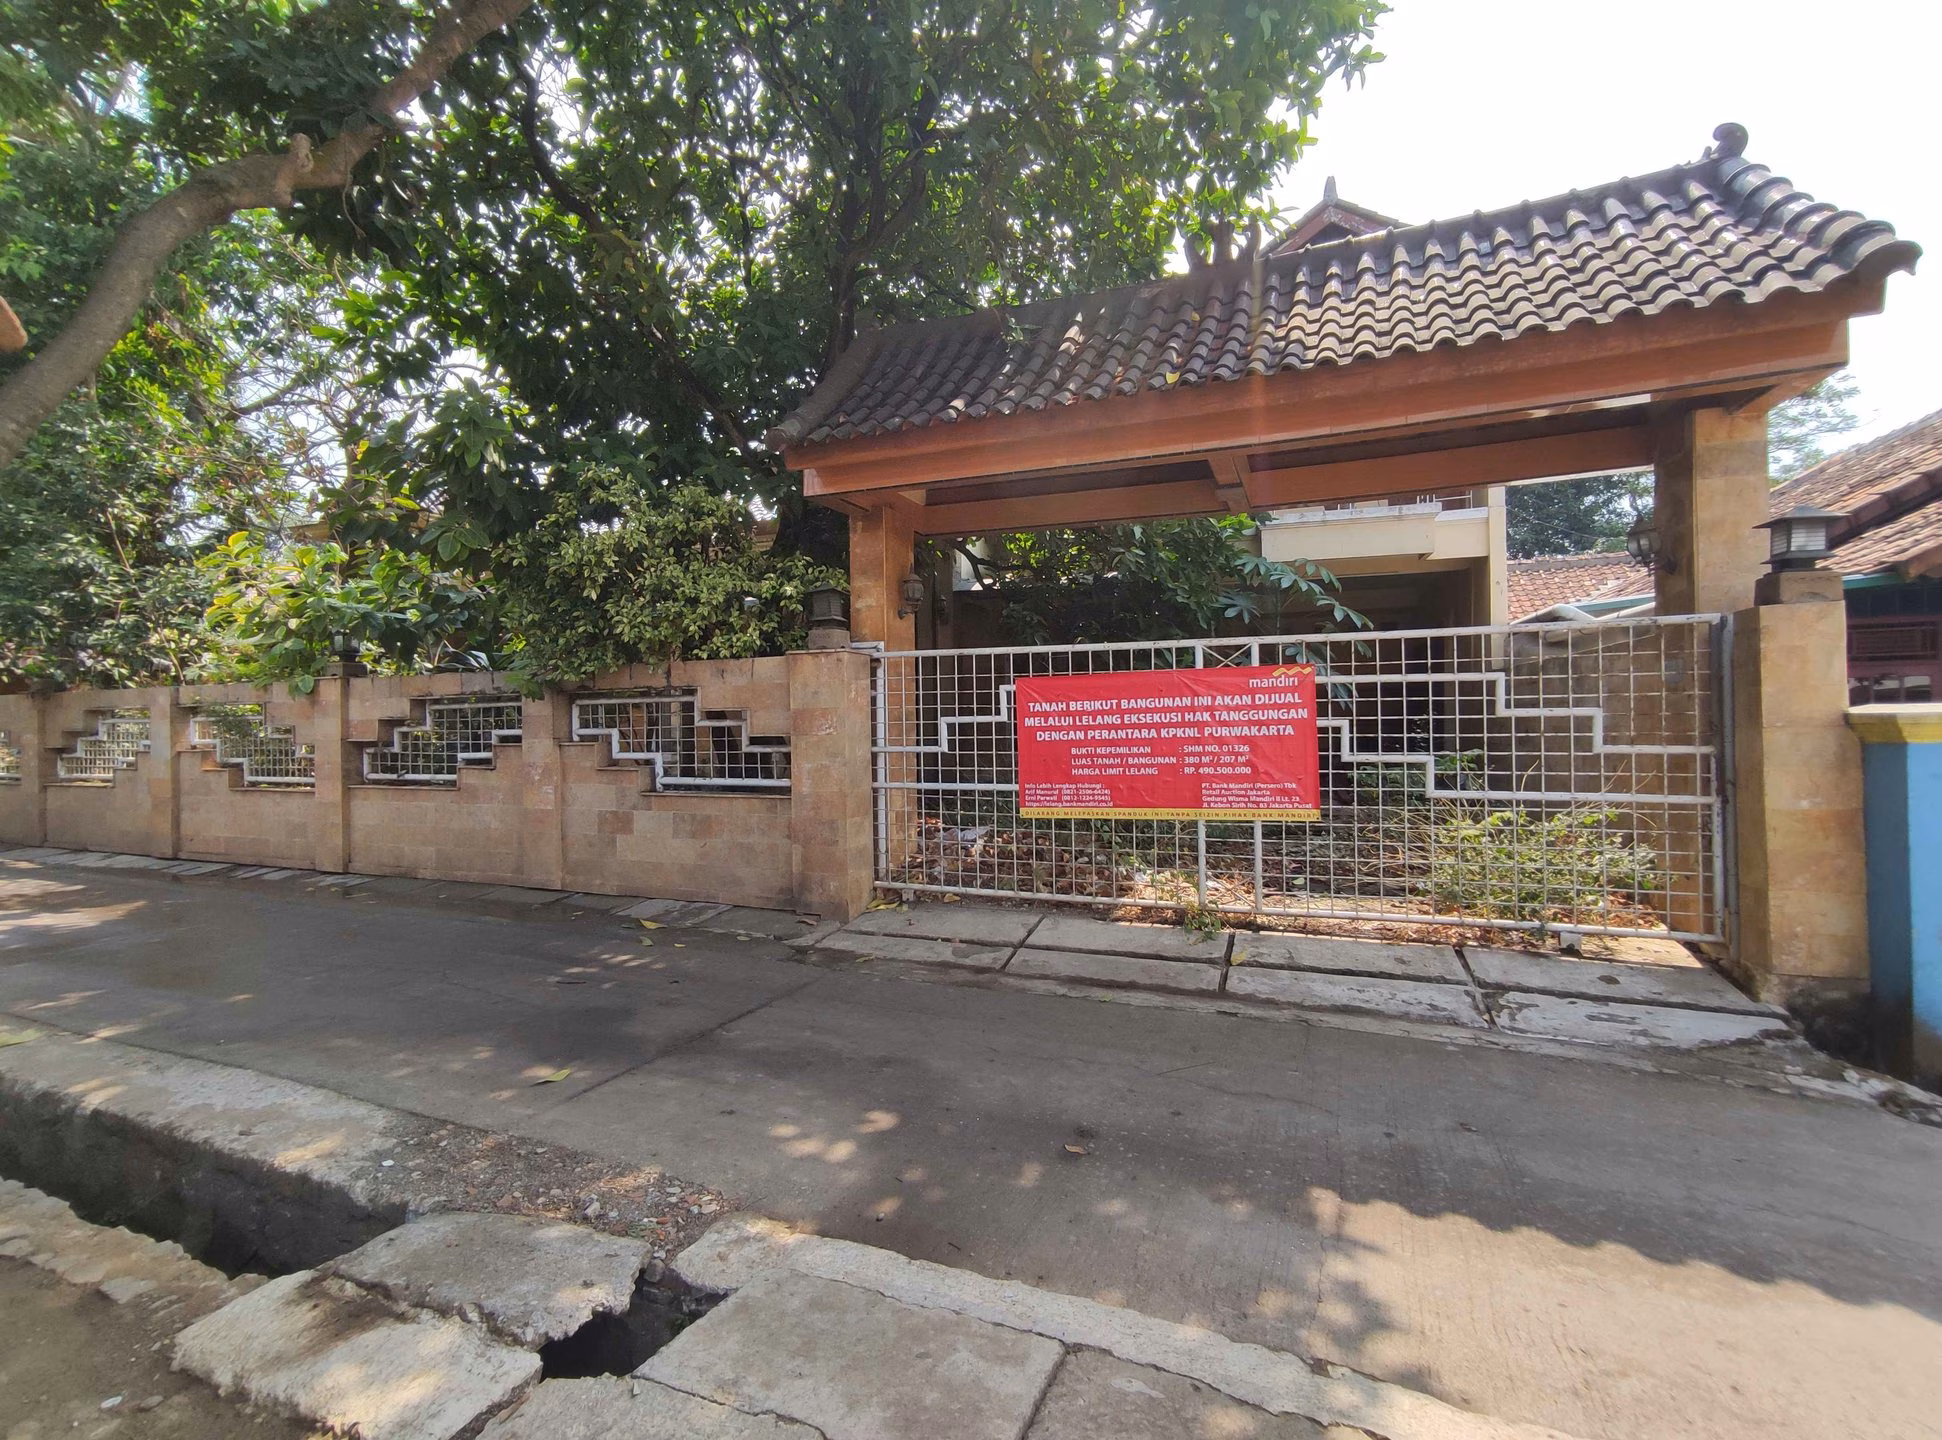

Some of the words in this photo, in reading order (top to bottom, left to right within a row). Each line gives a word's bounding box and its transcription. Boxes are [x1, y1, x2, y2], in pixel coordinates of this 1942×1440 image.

[1249, 675, 1298, 688] mandiri
[1028, 702, 1066, 712] TANAH
[1069, 700, 1118, 711] BERIKUT
[1121, 697, 1191, 709] BANGUNAN
[1194, 696, 1212, 706] INI
[1215, 695, 1252, 705] AKAN
[1255, 693, 1303, 705] DIJUAL
[1024, 716, 1073, 727] MELALUI
[1076, 714, 1121, 725] LELANG
[1124, 712, 1182, 724] EKSEKUSI
[1185, 711, 1211, 722] HAK
[1213, 708, 1308, 721] TANGGUNGAN
[1037, 731, 1085, 741] DENGAN
[1087, 728, 1157, 740] PERANTARA
[1161, 727, 1201, 738] KPKNL
[1204, 725, 1295, 737] PURWAKARTA
[1071, 747, 1095, 755] BUKTI
[1096, 746, 1152, 755] KEPEMILIKAN
[1183, 745, 1203, 753] SHM
[1205, 745, 1221, 753] NO.
[1222, 744, 1250, 752] 01326
[1093, 757, 1121, 765] TANAH
[1128, 757, 1177, 765] BANGUNAN
[1072, 768, 1100, 776] HARGA
[1126, 767, 1159, 775] LELANG
[1184, 767, 1197, 775] RP.
[1198, 767, 1252, 775] 490.500.000
